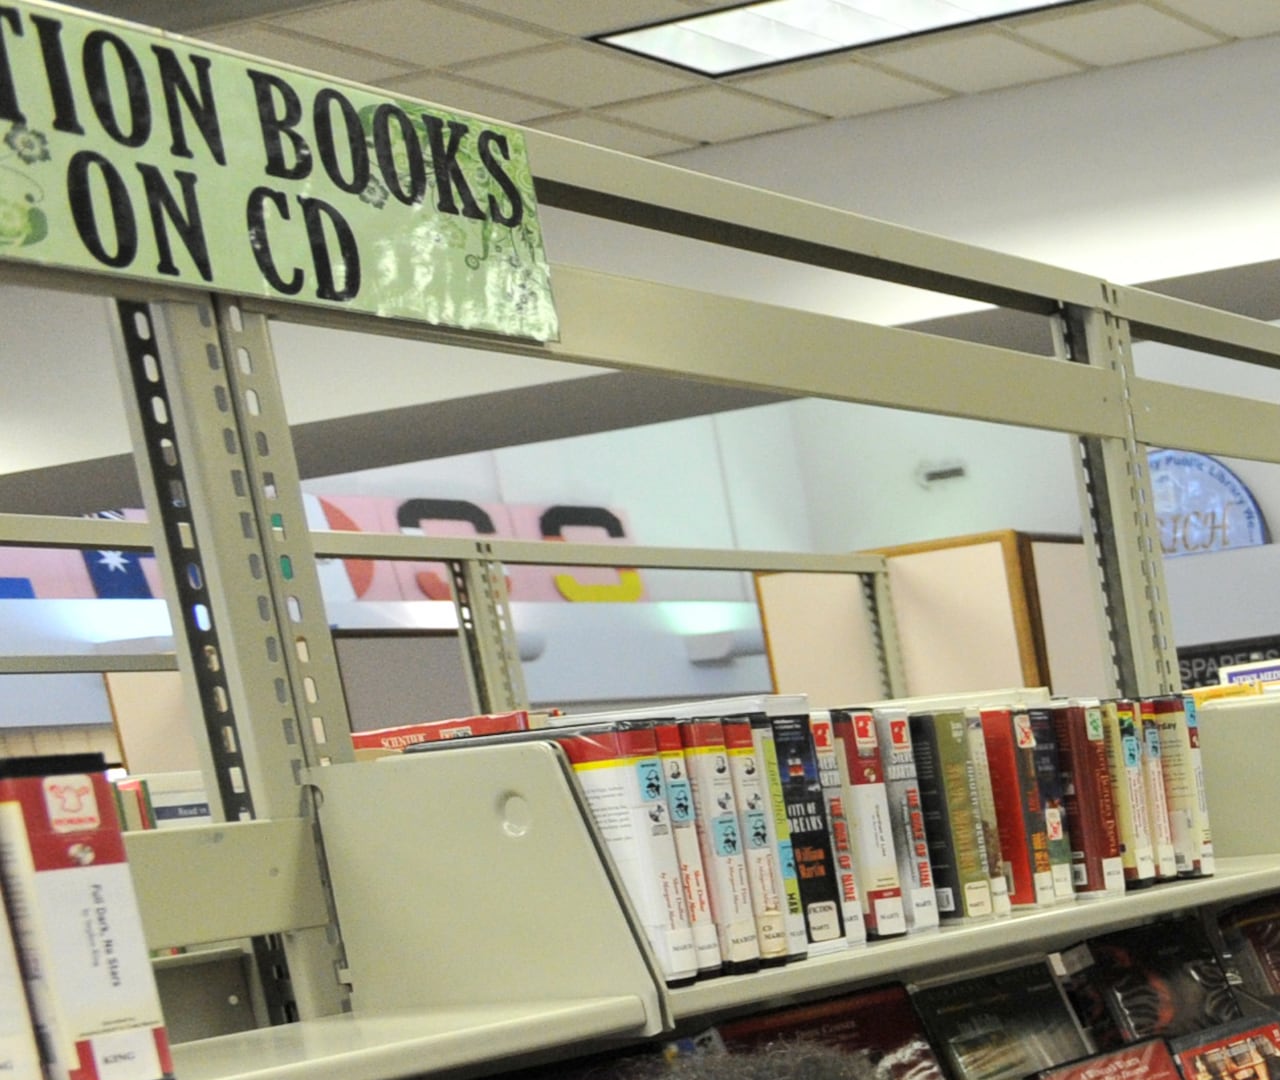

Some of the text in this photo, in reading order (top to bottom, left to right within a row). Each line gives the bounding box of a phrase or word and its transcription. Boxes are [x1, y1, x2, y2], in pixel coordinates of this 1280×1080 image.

[247, 69, 525, 228] BOOKS
[67, 150, 361, 301] ON CD
[837, 853, 852, 869] OF
[914, 843, 927, 857] OF
[840, 872, 857, 902] NINE
[916, 861, 931, 888] NINE
[89, 882, 106, 905] Full
[101, 937, 116, 955] No
[105, 955, 124, 987] Stars
